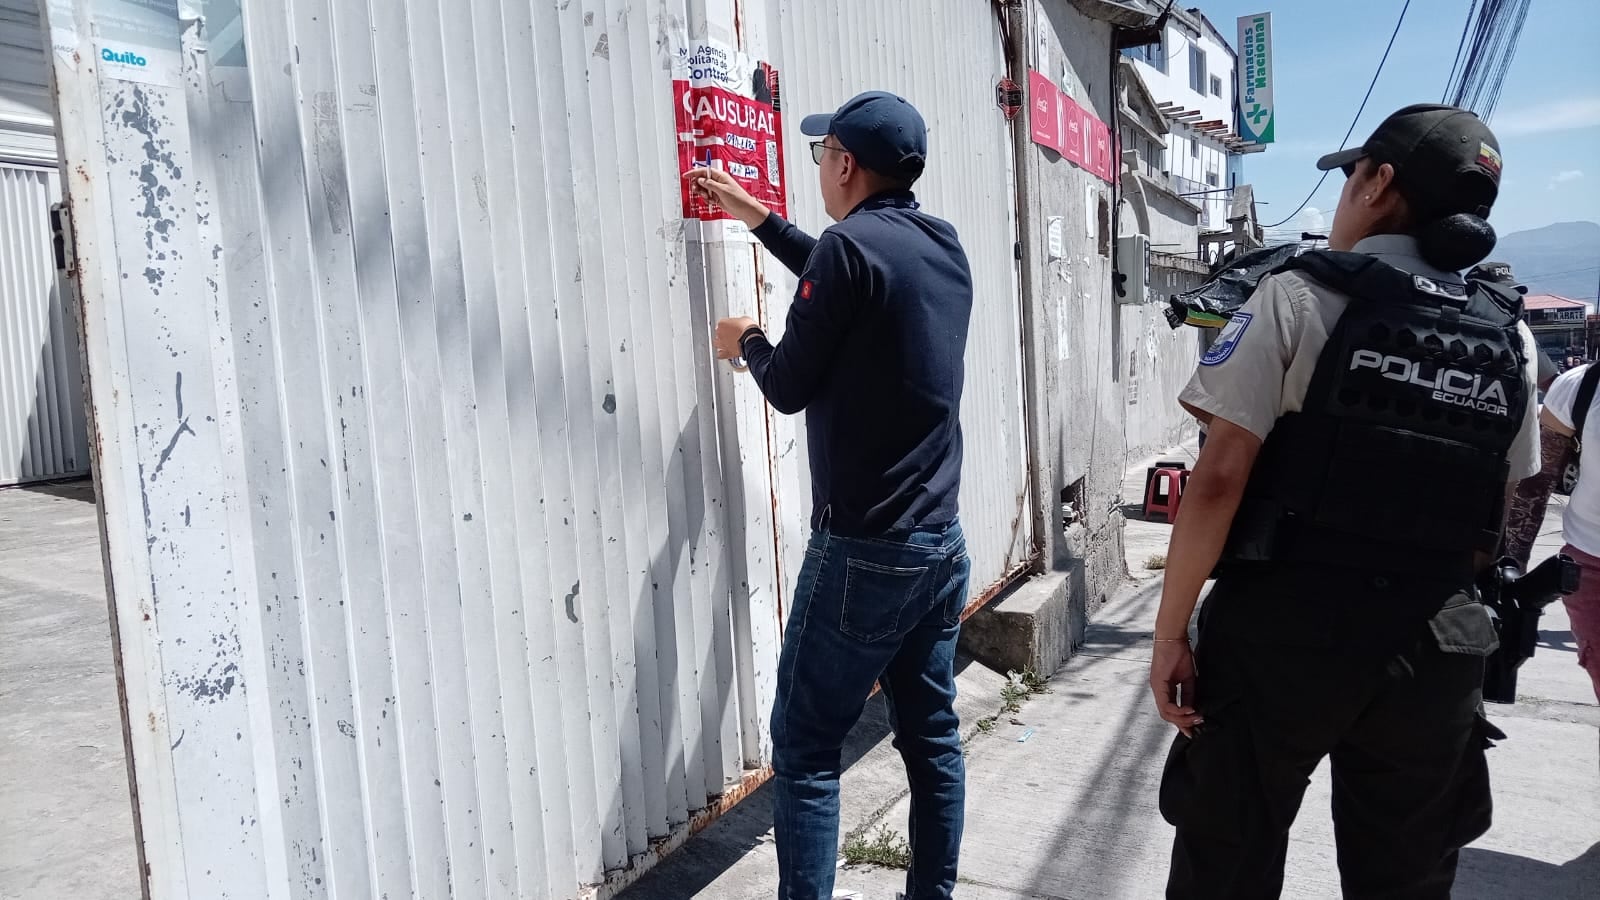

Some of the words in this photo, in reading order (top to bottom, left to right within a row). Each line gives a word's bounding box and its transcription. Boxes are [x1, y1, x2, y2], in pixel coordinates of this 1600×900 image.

[102, 48, 146, 66] Quito
[697, 45, 726, 60] Agencia
[1245, 27, 1255, 103] Farmacias
[1253, 17, 1266, 88] Nacional
[1432, 390, 1508, 416] ECUADOR
